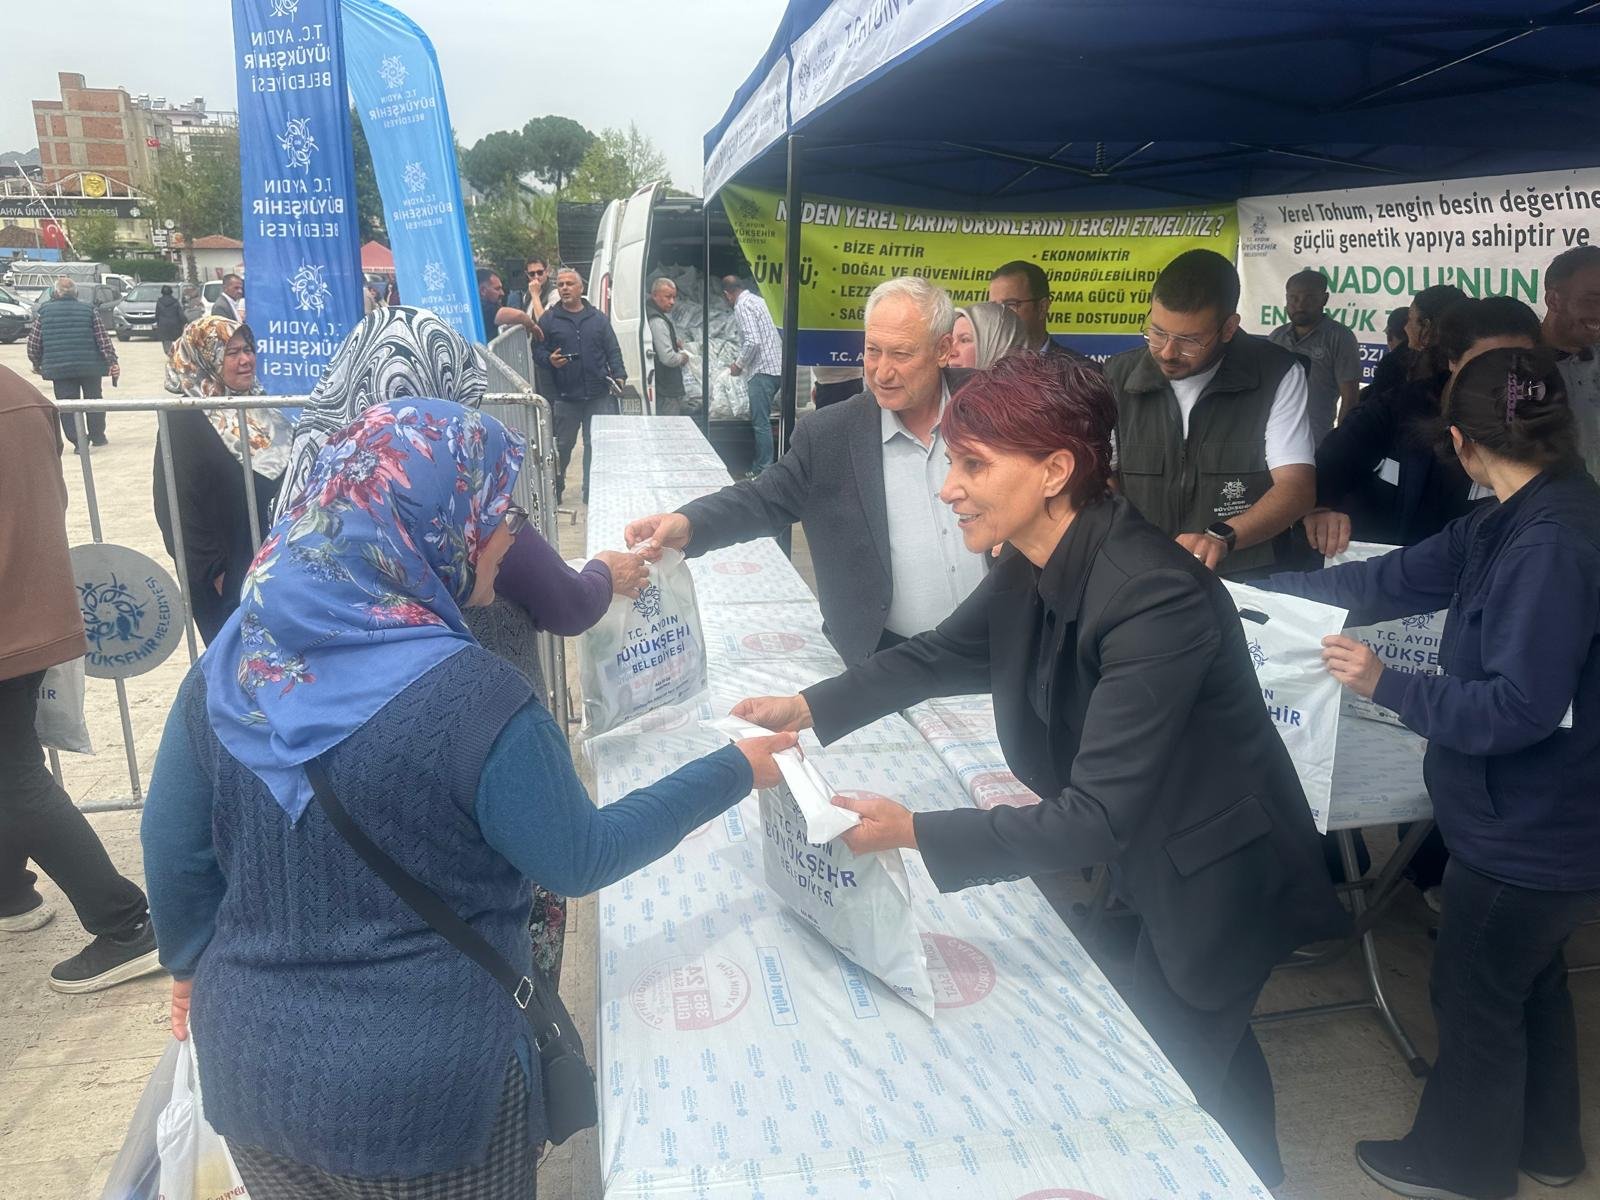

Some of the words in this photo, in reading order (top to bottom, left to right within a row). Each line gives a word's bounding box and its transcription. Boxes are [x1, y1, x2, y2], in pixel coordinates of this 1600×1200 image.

[0, 207, 23, 216] AHYA
[1279, 206, 1315, 224] Yerel
[1316, 203, 1373, 223] Tohum,
[1377, 196, 1435, 222] zengin
[1439, 190, 1494, 216] besin
[1500, 185, 1600, 218] değerine
[776, 199, 841, 227] NDEN
[844, 206, 899, 230] YEREL
[903, 212, 957, 234] TARIM
[1129, 211, 1211, 237] ETMELİYİZ
[843, 240, 876, 255] BİZE
[879, 242, 925, 258] AİTTİR
[1293, 231, 1335, 254] güçlü
[1339, 227, 1401, 252] genetik
[1404, 230, 1465, 253] yapıya
[1472, 222, 1556, 253] sahiptir
[1562, 228, 1590, 246] ve
[1041, 248, 1130, 261] EKONOMİKTİR
[753, 255, 819, 290] ÜNÜ;
[841, 262, 886, 277] DOĞAL
[891, 266, 909, 277] VE
[913, 266, 993, 281] GÜVENİLİRD
[841, 286, 874, 298] LEZZ
[1088, 289, 1125, 303] GÜCÜ
[1303, 265, 1539, 304] NADOLU'NUN
[1047, 312, 1072, 323] VRE
[1076, 312, 1146, 325] DOSTUDUR
[1325, 302, 1377, 332] YÜK
[830, 351, 852, 362] T.C.
[628, 627, 647, 641] T.C.
[651, 614, 679, 634] AYDIN
[1377, 630, 1400, 642] T.C.
[1404, 634, 1438, 647] AYDI
[616, 623, 690, 666] ÜYÜKŞEHİ
[632, 642, 685, 674] BELEDİYESİ
